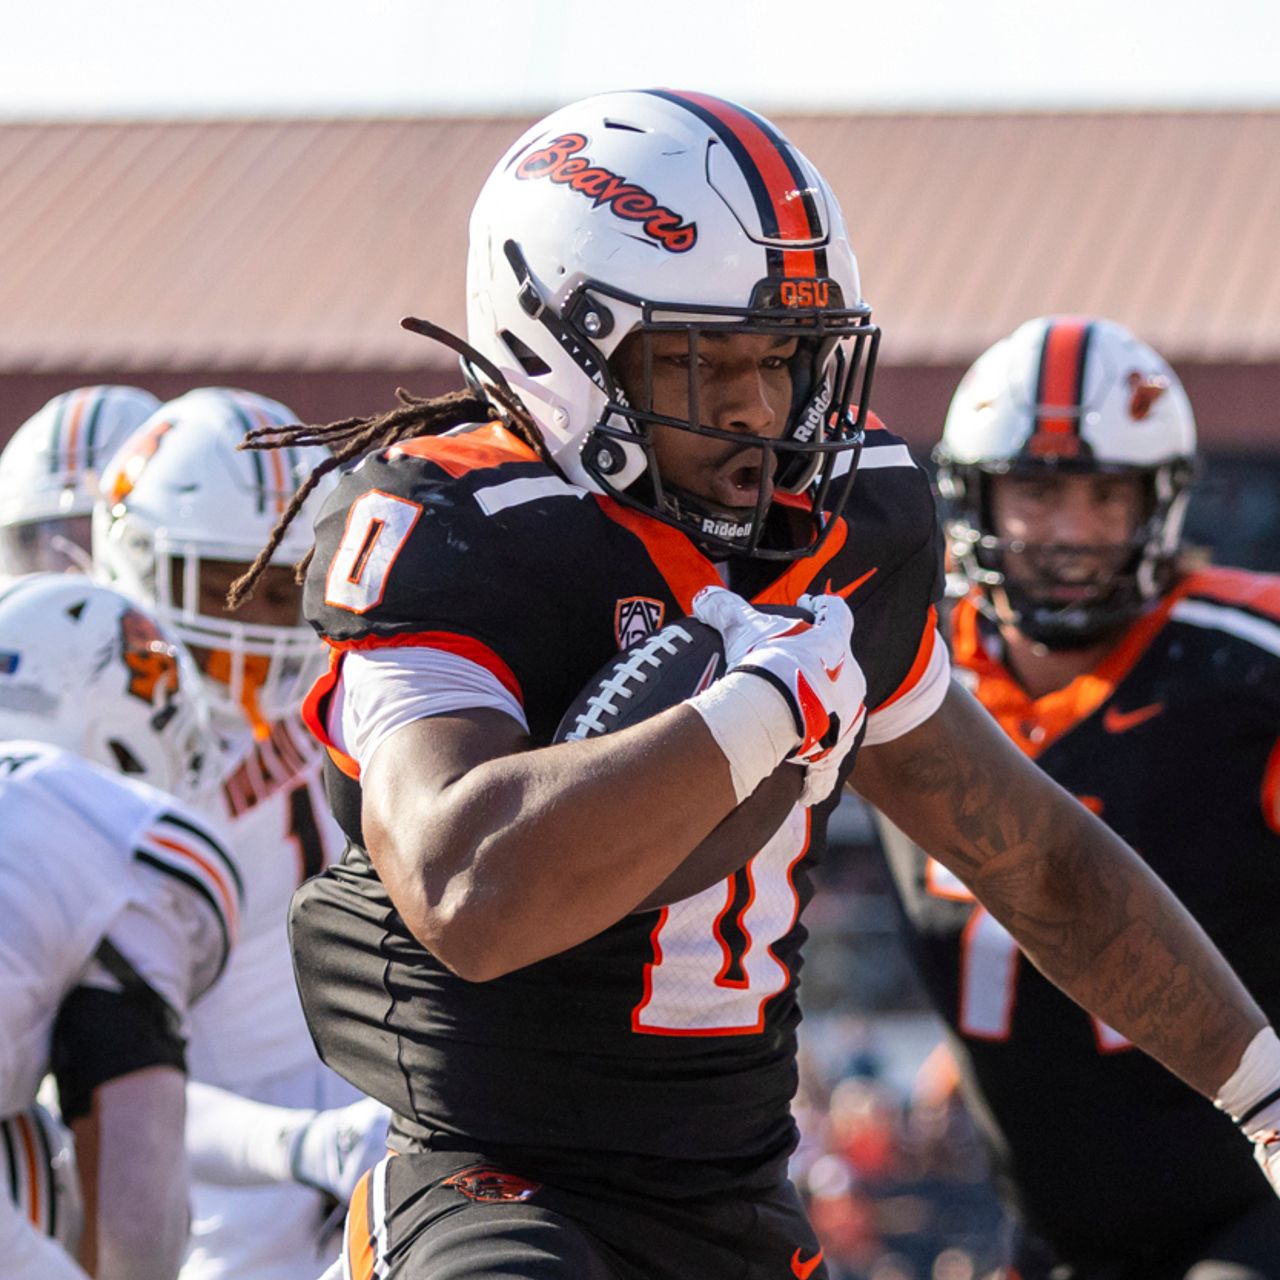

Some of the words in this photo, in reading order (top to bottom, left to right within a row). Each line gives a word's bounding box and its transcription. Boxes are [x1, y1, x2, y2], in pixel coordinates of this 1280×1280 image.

[515, 132, 698, 253] Beavers
[780, 281, 829, 308] OSU
[324, 488, 424, 615] 0
[701, 518, 752, 538] Riddell
